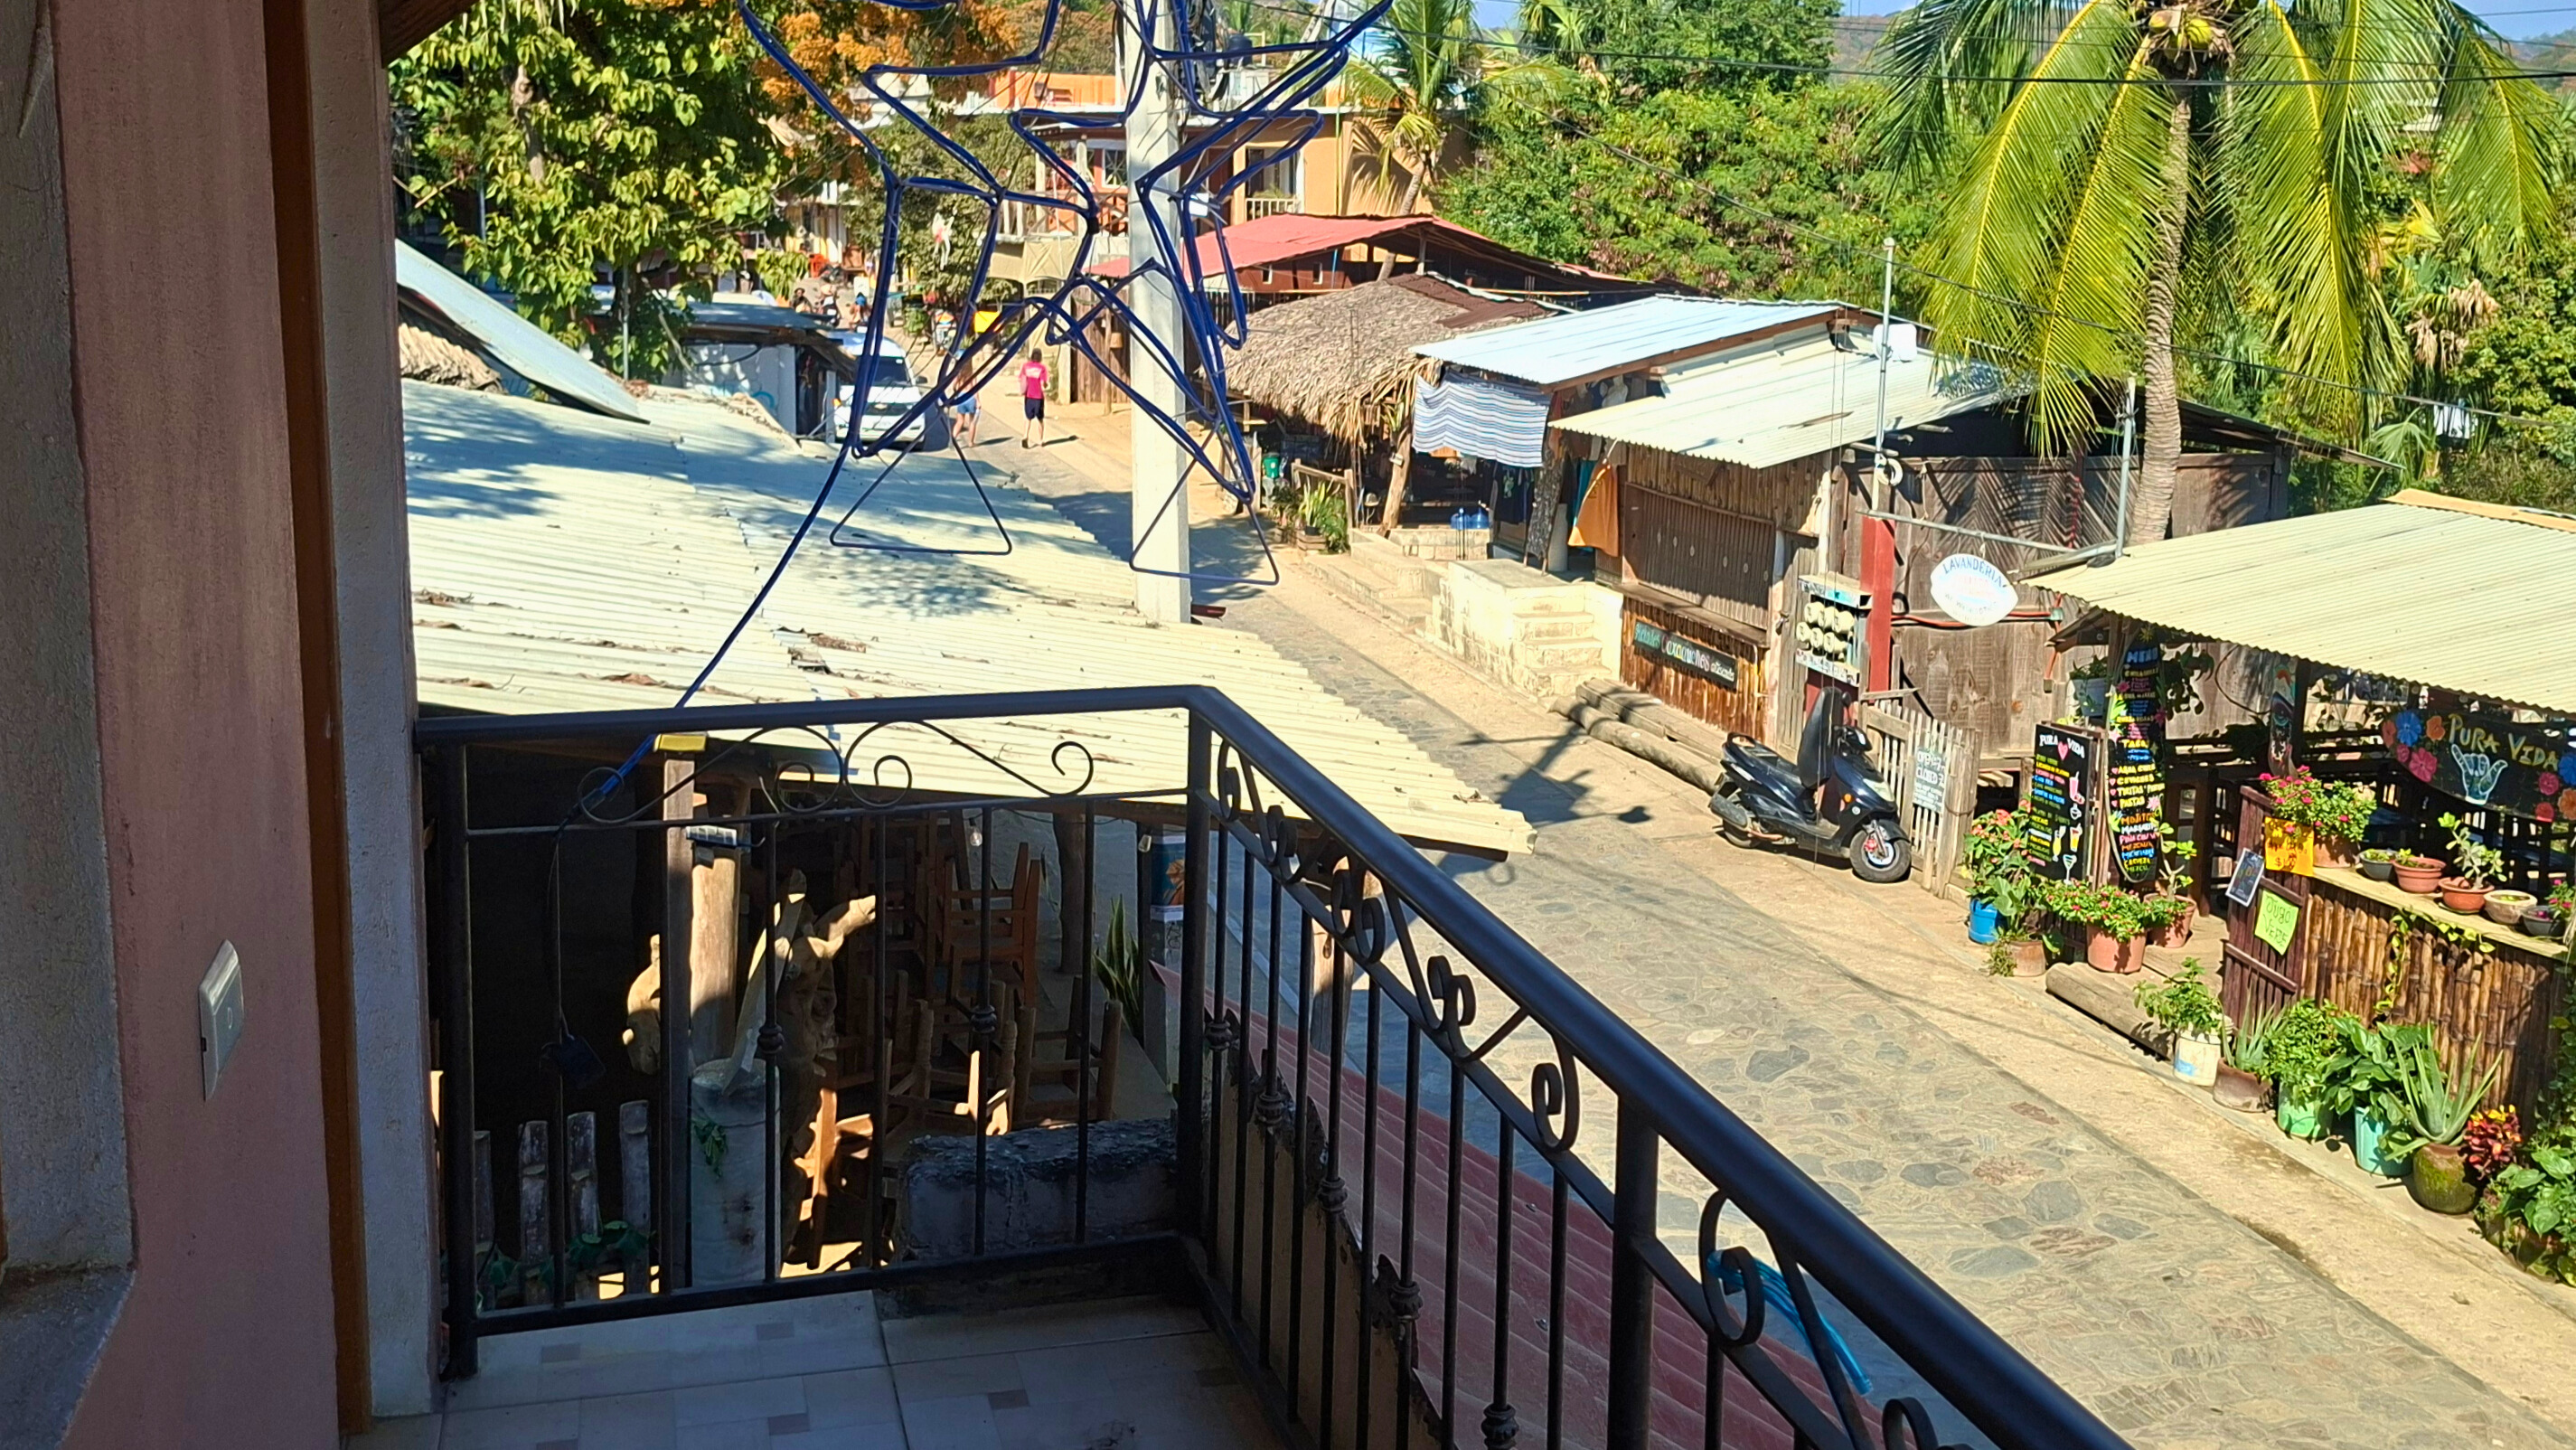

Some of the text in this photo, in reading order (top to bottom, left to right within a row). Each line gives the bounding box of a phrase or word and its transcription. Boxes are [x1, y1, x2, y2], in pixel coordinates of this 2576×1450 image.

[1942, 556, 2002, 588] LAVANDERIA
[2039, 734, 2086, 758] PURA VIDA
[2449, 713, 2559, 771] PURA VIDA
